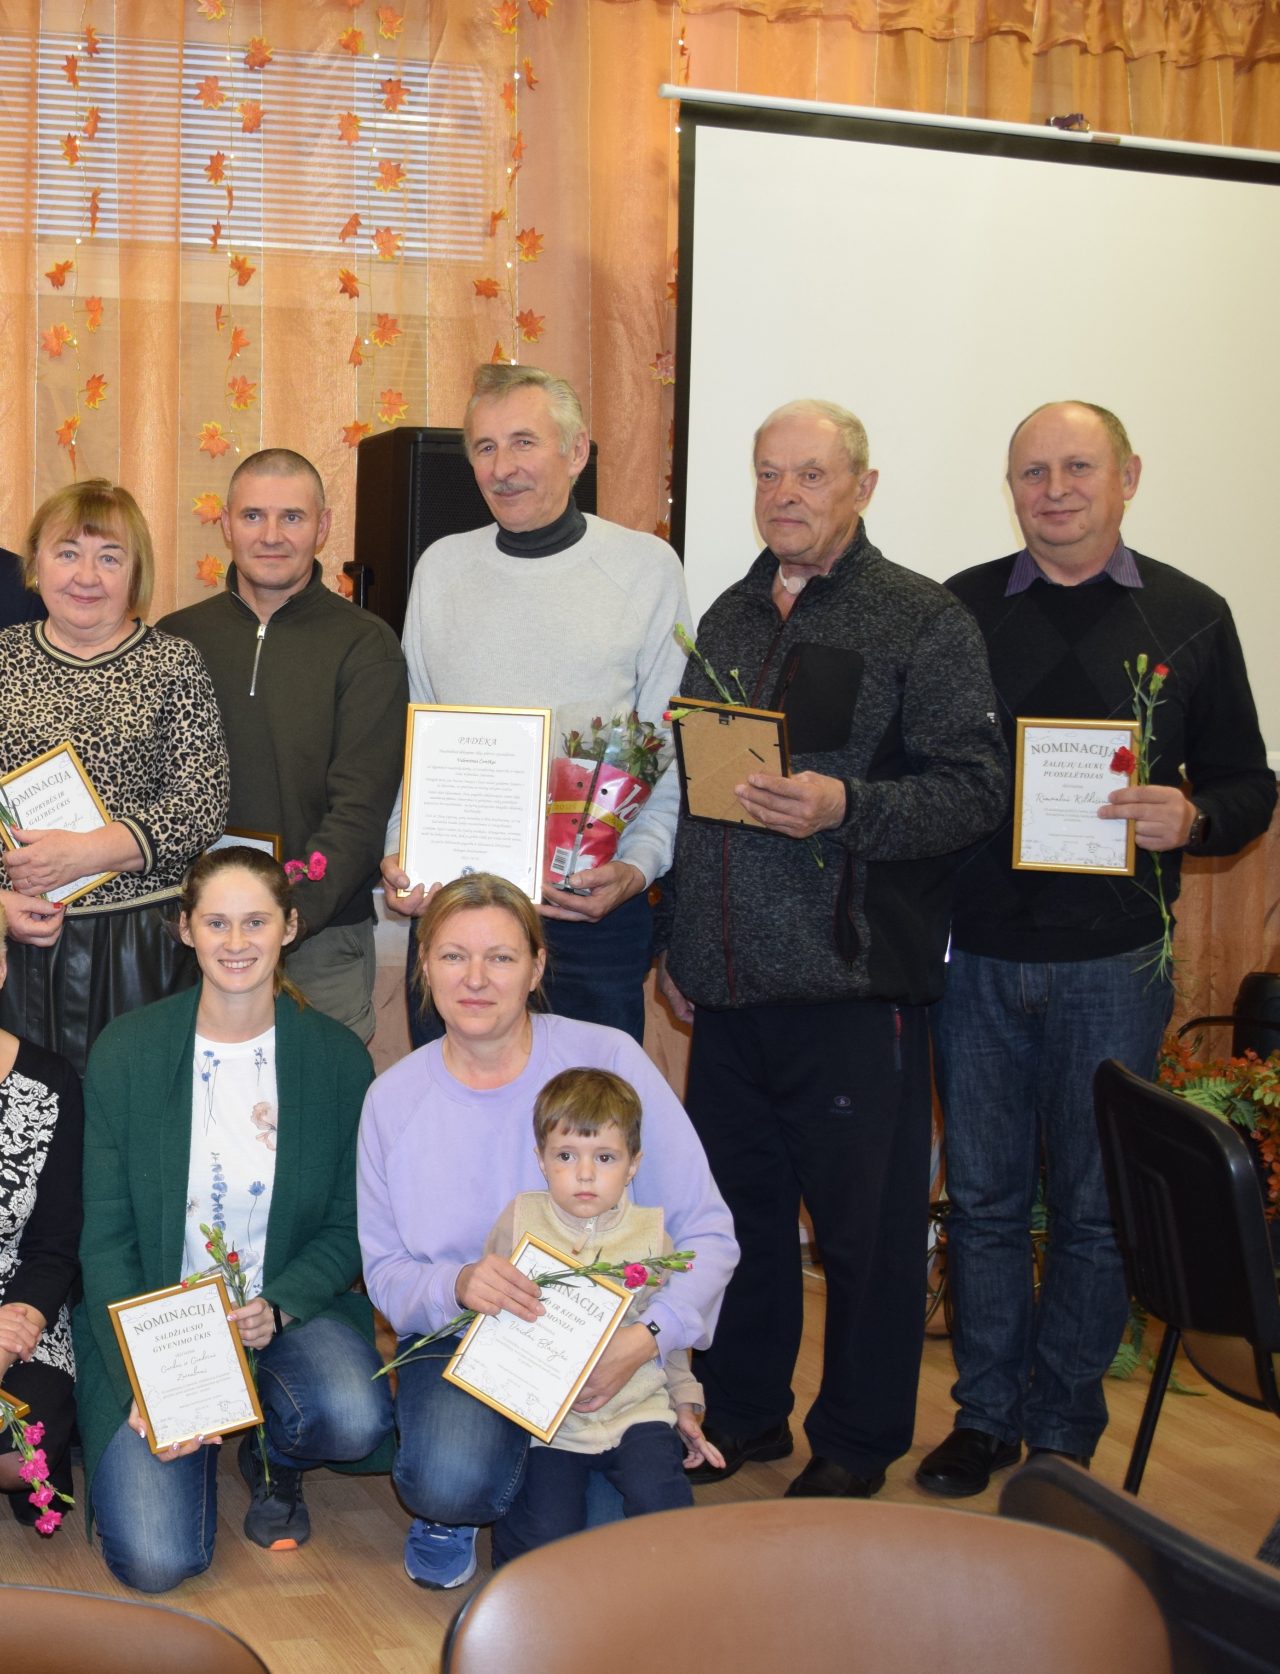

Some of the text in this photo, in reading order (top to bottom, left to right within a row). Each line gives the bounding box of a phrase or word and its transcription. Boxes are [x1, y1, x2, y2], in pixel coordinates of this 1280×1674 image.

[6, 770, 72, 809] OMINACIJA
[133, 1303, 216, 1335] NOMINACIJA
[561, 1307, 586, 1326] KIEMO
[154, 1323, 204, 1342] SALDŽIAUSIO
[152, 1336, 192, 1354] GYVENIMO
